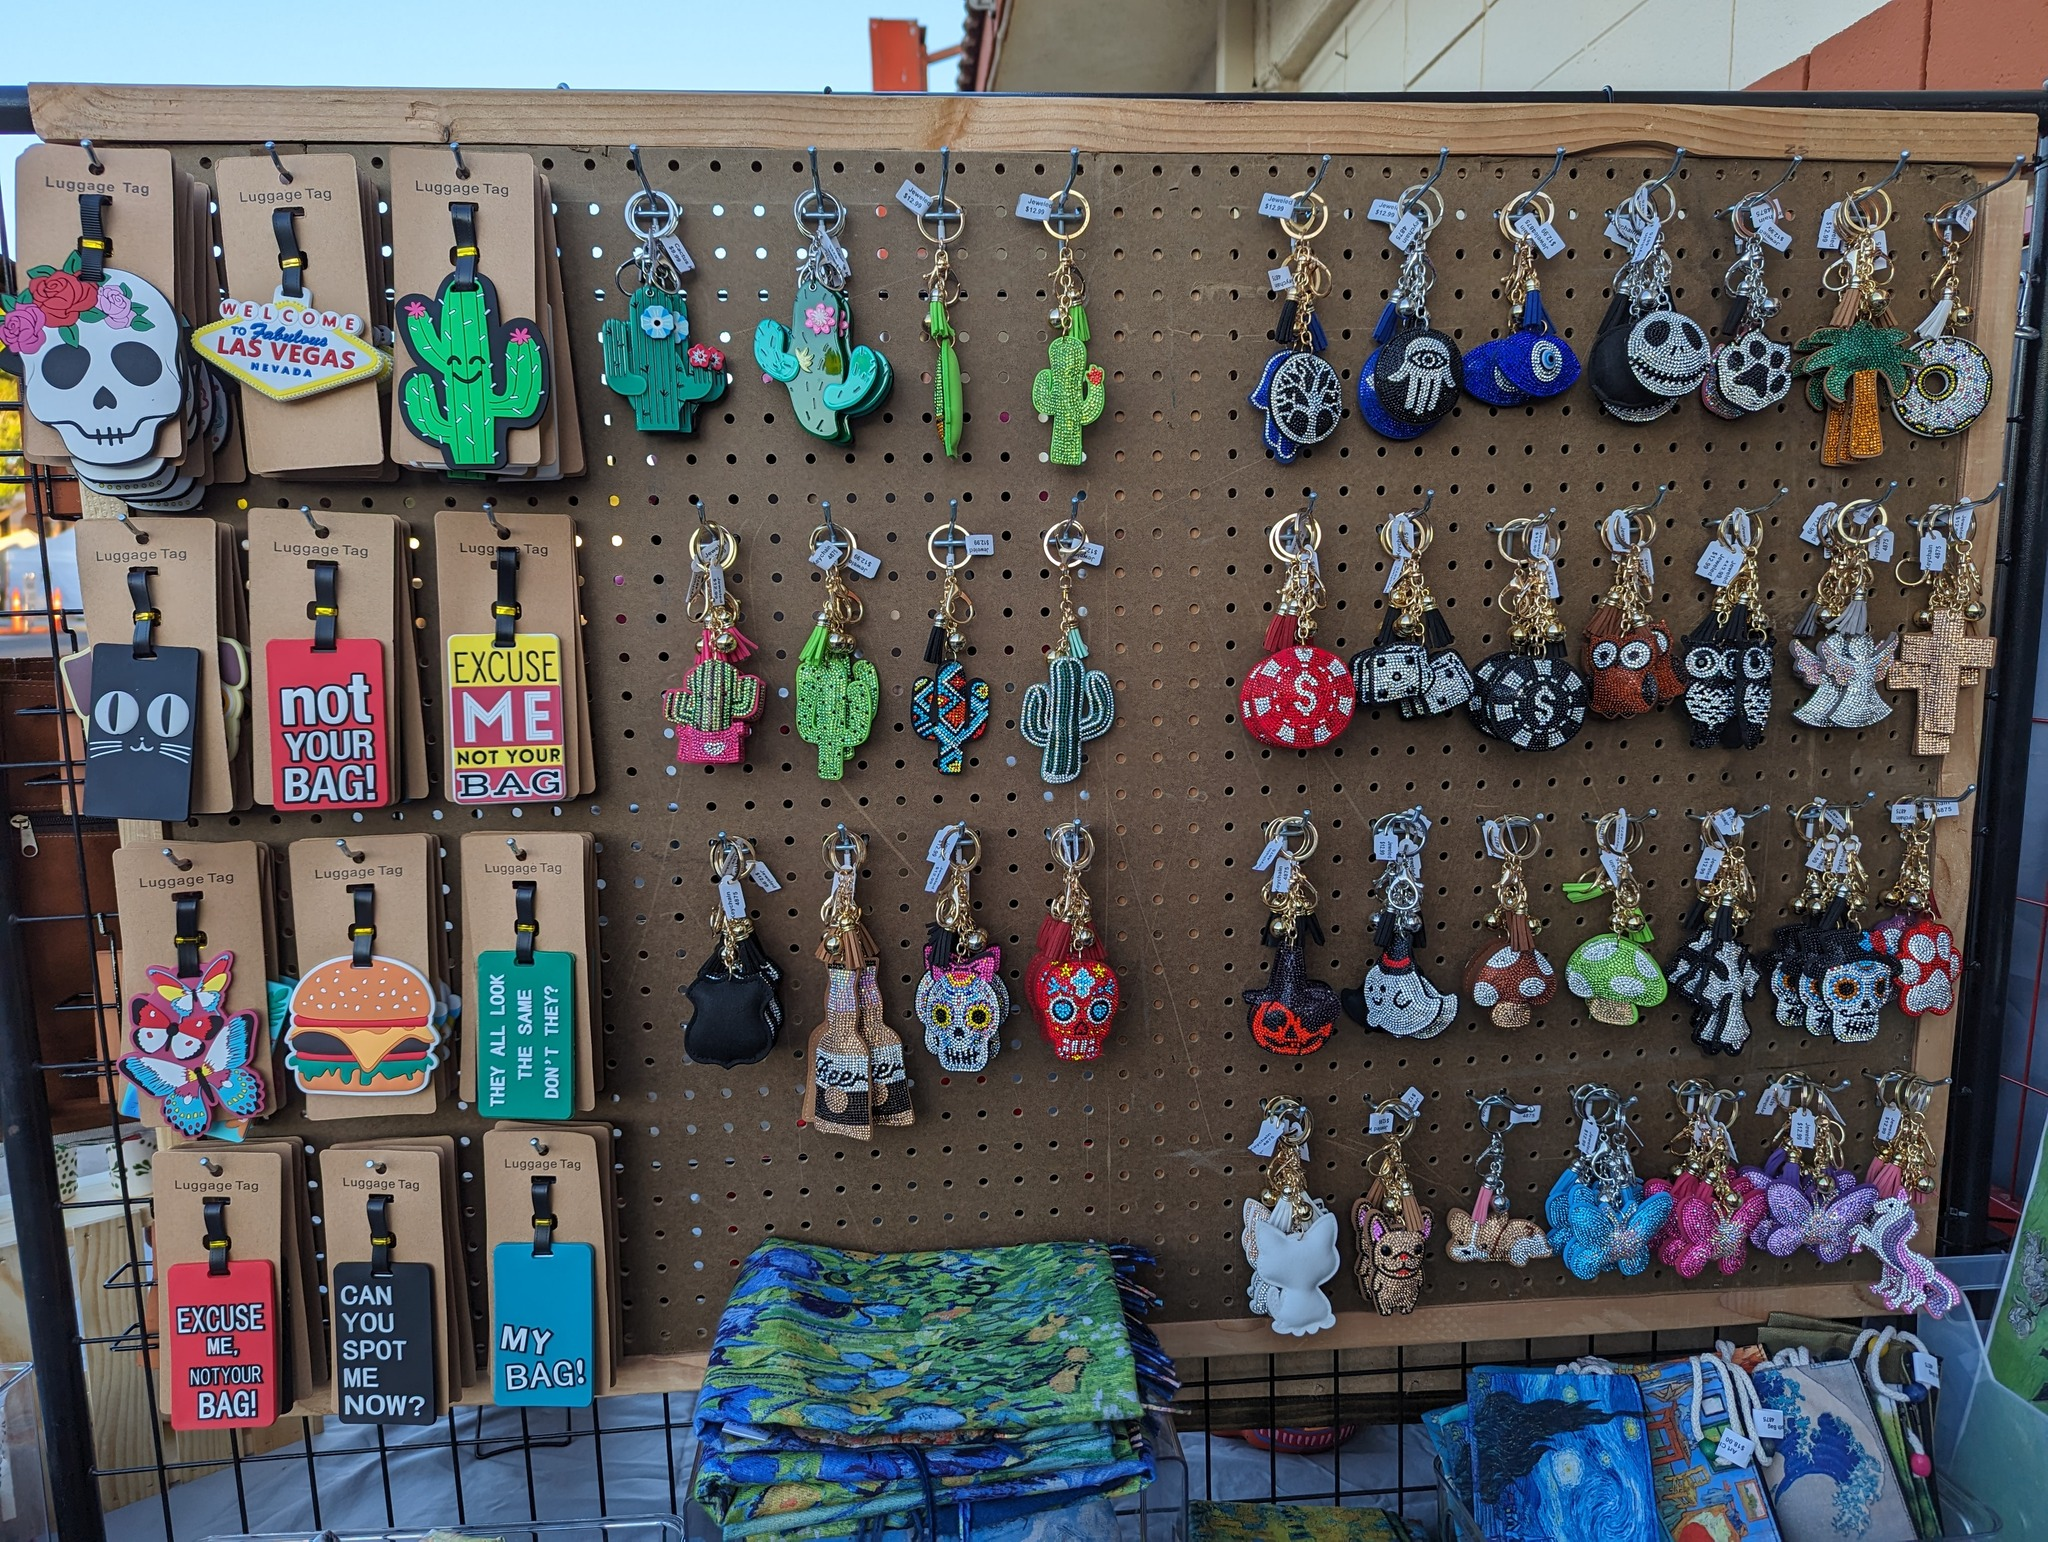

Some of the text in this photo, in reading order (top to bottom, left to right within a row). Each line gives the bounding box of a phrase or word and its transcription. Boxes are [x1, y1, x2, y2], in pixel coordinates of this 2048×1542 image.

[45, 176, 150, 197] Luggage Tag
[239, 188, 332, 204] Luggage Tag
[415, 180, 509, 198] Luggage Tag
[903, 192, 923, 208] $12.99
[908, 187, 932, 207] Jeweled
[1027, 198, 1053, 209] Jeweled
[1267, 195, 1293, 206] Jeweled
[1024, 206, 1045, 215] $12.99
[1265, 203, 1285, 212] $12.99
[1374, 209, 1395, 218] $12.99
[1395, 225, 1408, 241] 4875
[1540, 227, 1557, 247] $12.99
[1767, 226, 1785, 242] $12.99
[1822, 222, 1833, 243] $12.99
[221, 303, 355, 331] WELCOME
[230, 322, 329, 348] TO Fabulous
[217, 336, 356, 370] LAS VEGAS
[250, 362, 313, 378] NEVADA
[272, 541, 369, 559] Luggage Tag
[460, 542, 549, 557] Lugge Tag
[1882, 538, 1890, 552] 4875
[1934, 545, 1942, 560] 4875
[95, 548, 188, 564] Luggage Tag
[853, 553, 873, 568] $12.99
[1702, 551, 1718, 570] $12.99
[1708, 553, 1725, 577] Jeweled
[454, 650, 558, 683] EXCUSE
[280, 673, 372, 727] not
[462, 690, 554, 742] ME
[284, 729, 374, 761] YOUR
[457, 748, 561, 765] NOT YOUR
[283, 765, 376, 802] BAG!
[459, 771, 561, 797] BAG
[314, 865, 403, 881] Luggage Tag
[484, 862, 562, 875] Luggage Tag
[1409, 857, 1417, 877] eweled
[1699, 857, 1710, 875] $12.99
[139, 872, 235, 889] Luggage Tag
[754, 872, 769, 889] $12.99
[759, 870, 777, 890] Jeweled
[732, 891, 740, 906] 4875
[543, 985, 560, 1037] THEY?
[489, 973, 506, 1108] THEY ALL LOOK
[517, 989, 533, 1081] THE SAME
[1881, 1116, 1889, 1135] $12.99
[1885, 1117, 1895, 1140] Jeweled
[1262, 1135, 1275, 1146] 4875
[504, 1159, 581, 1171] Luggage Tag
[174, 1180, 259, 1193] Luggage Tag
[342, 1177, 420, 1192] Luggage Tag
[340, 1285, 393, 1306] CAN
[176, 1303, 265, 1334] EXCUSE
[342, 1312, 395, 1333] YOU
[206, 1336, 239, 1357] ME,
[501, 1324, 552, 1355] MY
[342, 1340, 407, 1361] SPOT
[343, 1367, 380, 1388] ME
[505, 1358, 587, 1391] BAG!
[198, 1390, 258, 1420] BAG!
[344, 1395, 426, 1417] NOW?
[1725, 1436, 1746, 1451] $18.00
